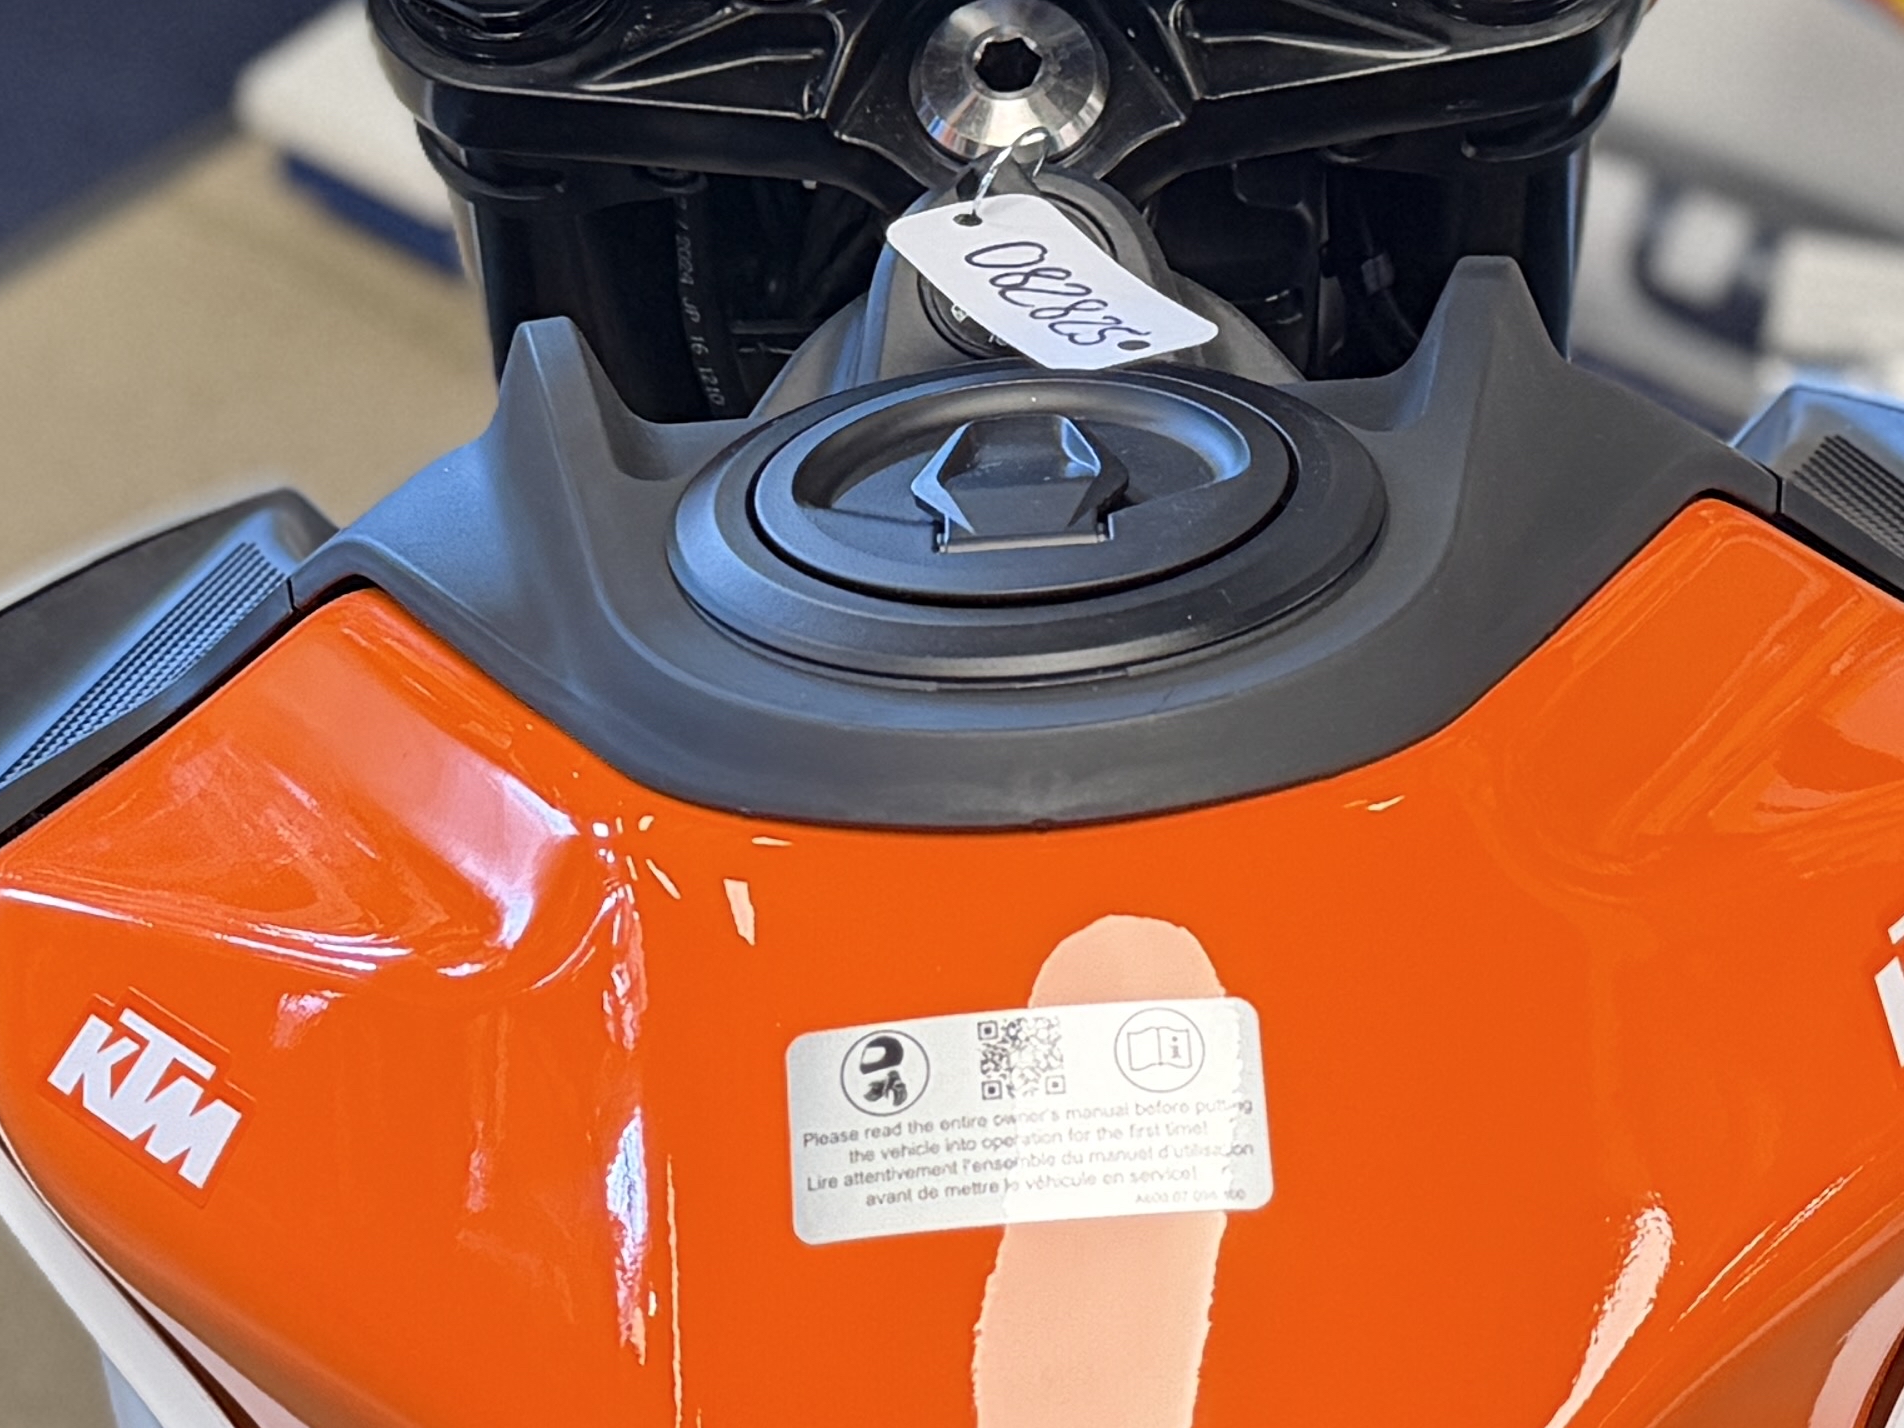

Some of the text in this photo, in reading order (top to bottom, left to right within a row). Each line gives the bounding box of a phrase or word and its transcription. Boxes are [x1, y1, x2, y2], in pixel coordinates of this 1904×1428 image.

[690, 335, 709, 355] 16
[47, 1007, 242, 1189] KTM
[802, 1128, 859, 1148] Please
[864, 1123, 902, 1140] read
[907, 1120, 934, 1135] the
[939, 1116, 988, 1131] entire
[1066, 1102, 1129, 1120] manual
[1135, 1099, 1190, 1116] before
[849, 1148, 875, 1164] the
[881, 1140, 940, 1160] vehicle
[945, 1137, 977, 1152] into
[1068, 1128, 1092, 1143] for
[1096, 1125, 1124, 1141] the
[1129, 1122, 1161, 1138] first
[807, 1174, 838, 1191] Lire
[843, 1161, 958, 1187] attentivement
[1061, 1147, 1084, 1165] du
[1089, 1144, 1154, 1163] manuel
[865, 1186, 913, 1206] avant
[917, 1183, 940, 1200] de
[945, 1178, 1000, 1197] mettre
[1102, 1169, 1125, 1186] en
